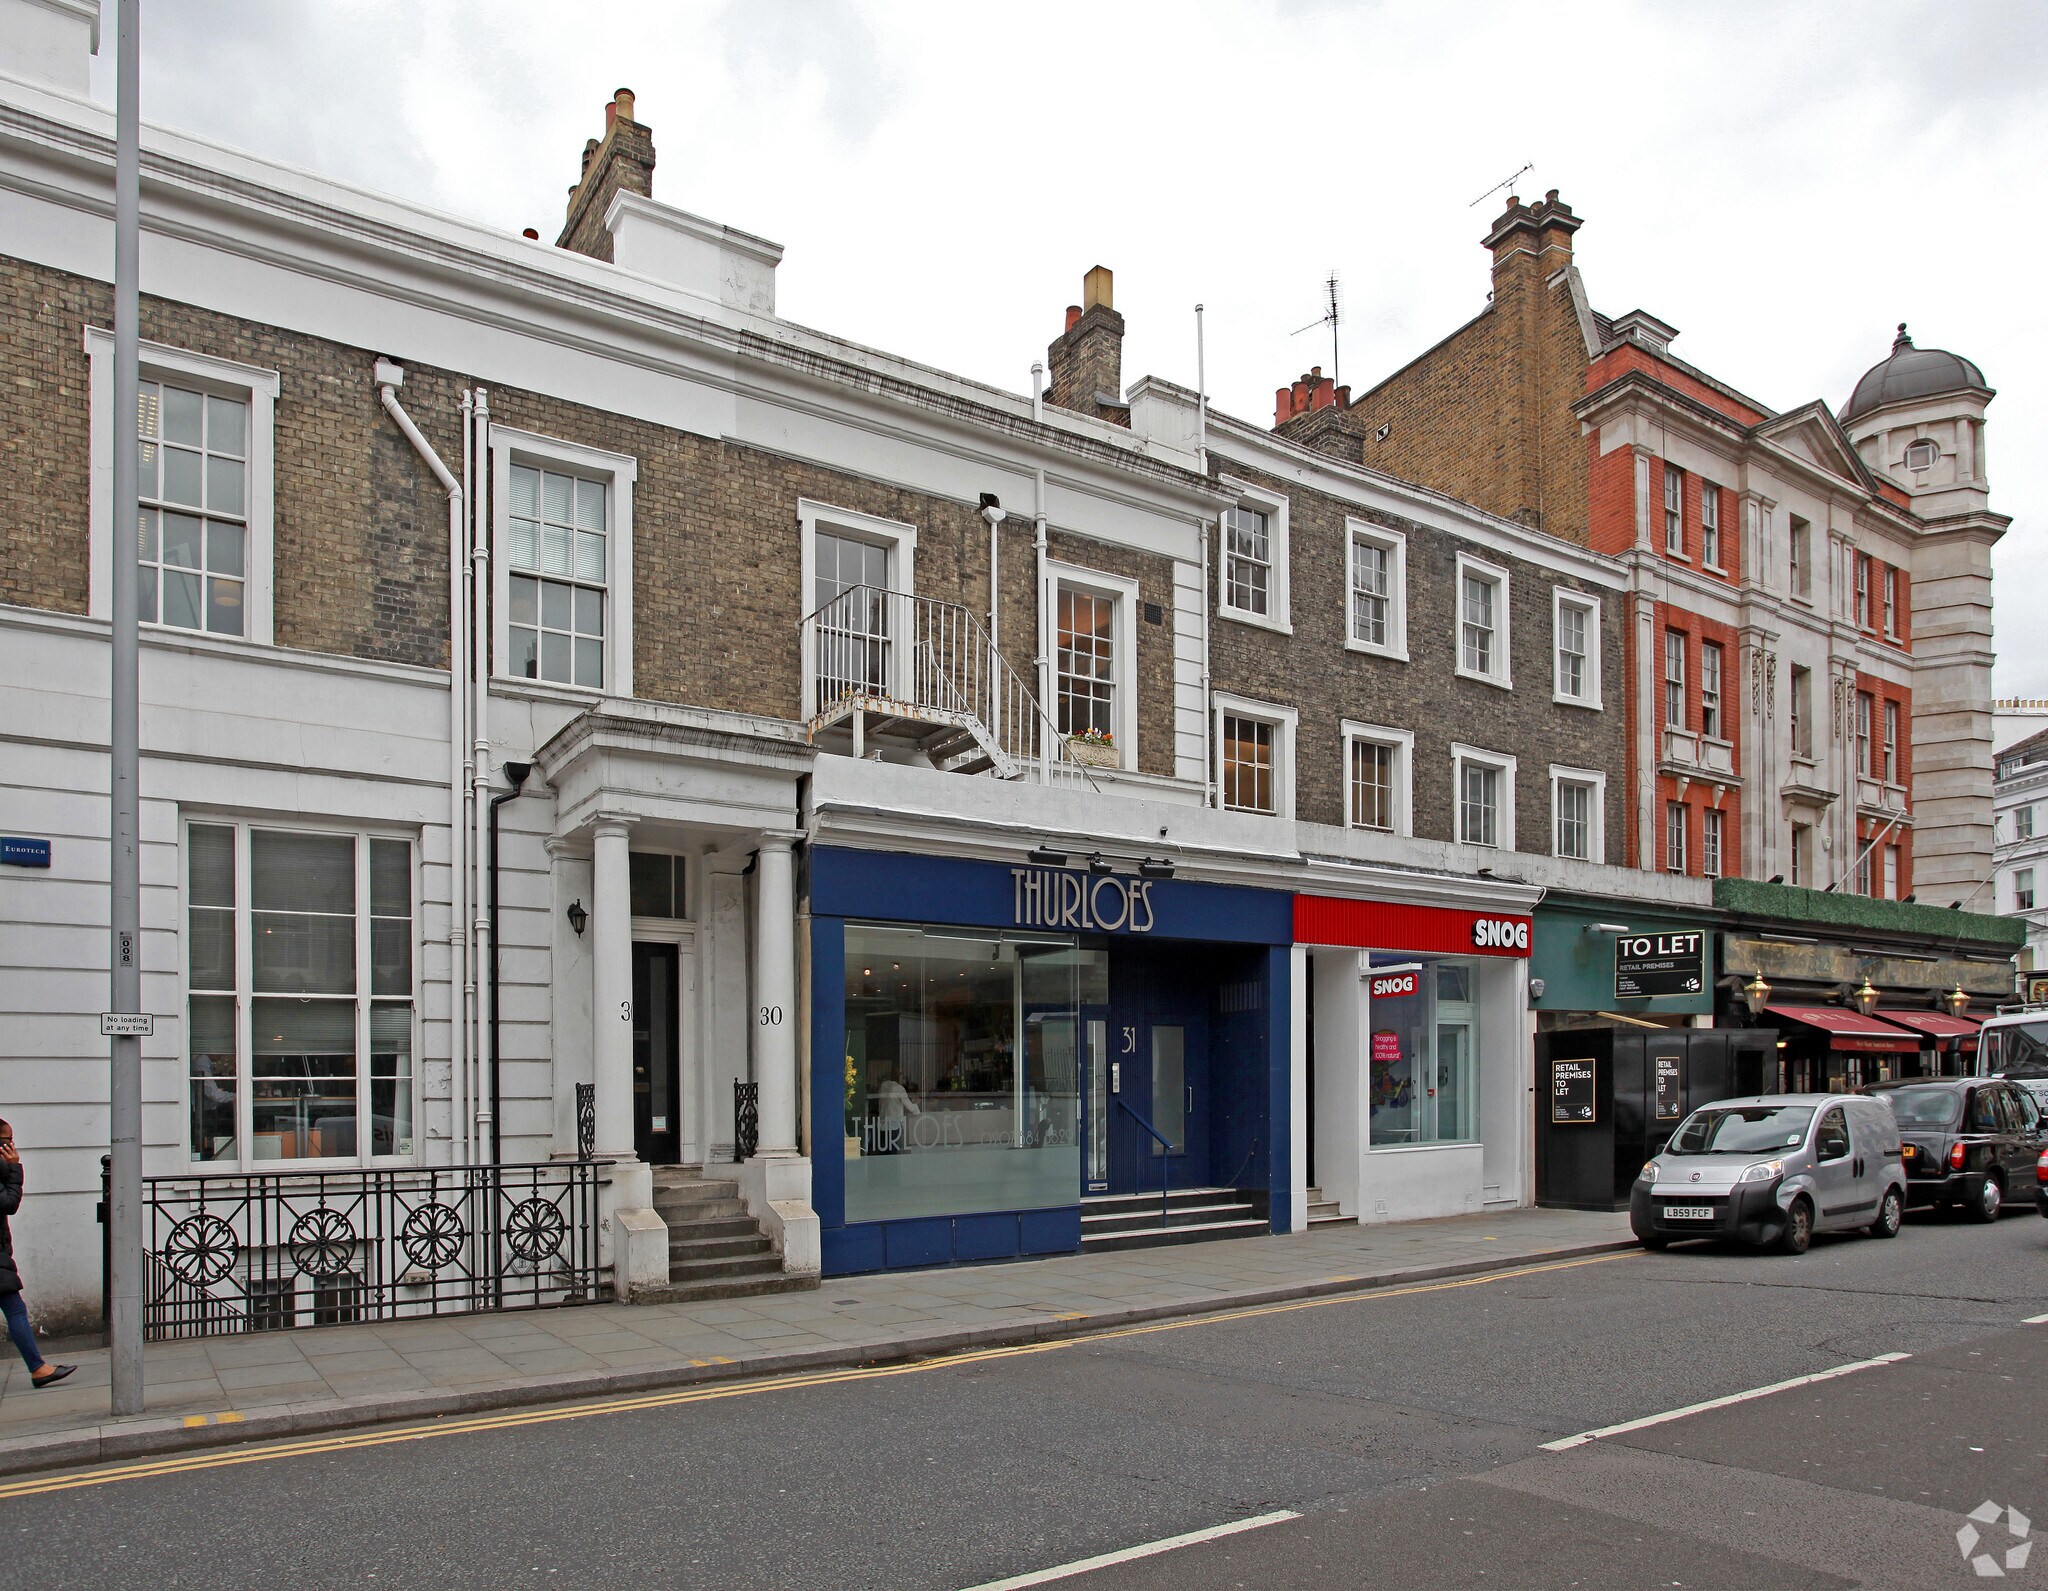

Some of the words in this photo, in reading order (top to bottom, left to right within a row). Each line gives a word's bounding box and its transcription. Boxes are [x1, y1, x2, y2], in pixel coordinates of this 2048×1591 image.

[5, 845, 46, 855] EUROTECH
[1011, 868, 1154, 932] THURLOES
[1475, 919, 1528, 948] SNOG
[1620, 938, 1651, 957] TO
[1658, 934, 1699, 955] LET
[1642, 961, 1675, 970] PREMISES
[1373, 976, 1413, 995] SNOG
[620, 1001, 634, 1022] 3
[760, 1006, 783, 1026] 30
[1121, 1026, 1136, 1053] 31
[1555, 1063, 1581, 1071] RETAIL
[1658, 1060, 1672, 1068] RETAIL
[1555, 1070, 1592, 1080] PREMISES
[1658, 1068, 1678, 1076] PREMISES
[1555, 1080, 1567, 1088] TO
[1658, 1076, 1665, 1084] TO
[1555, 1088, 1570, 1096] LET
[1666, 1208, 1690, 1218] LB59
[1692, 1209, 1710, 1218] FCF
